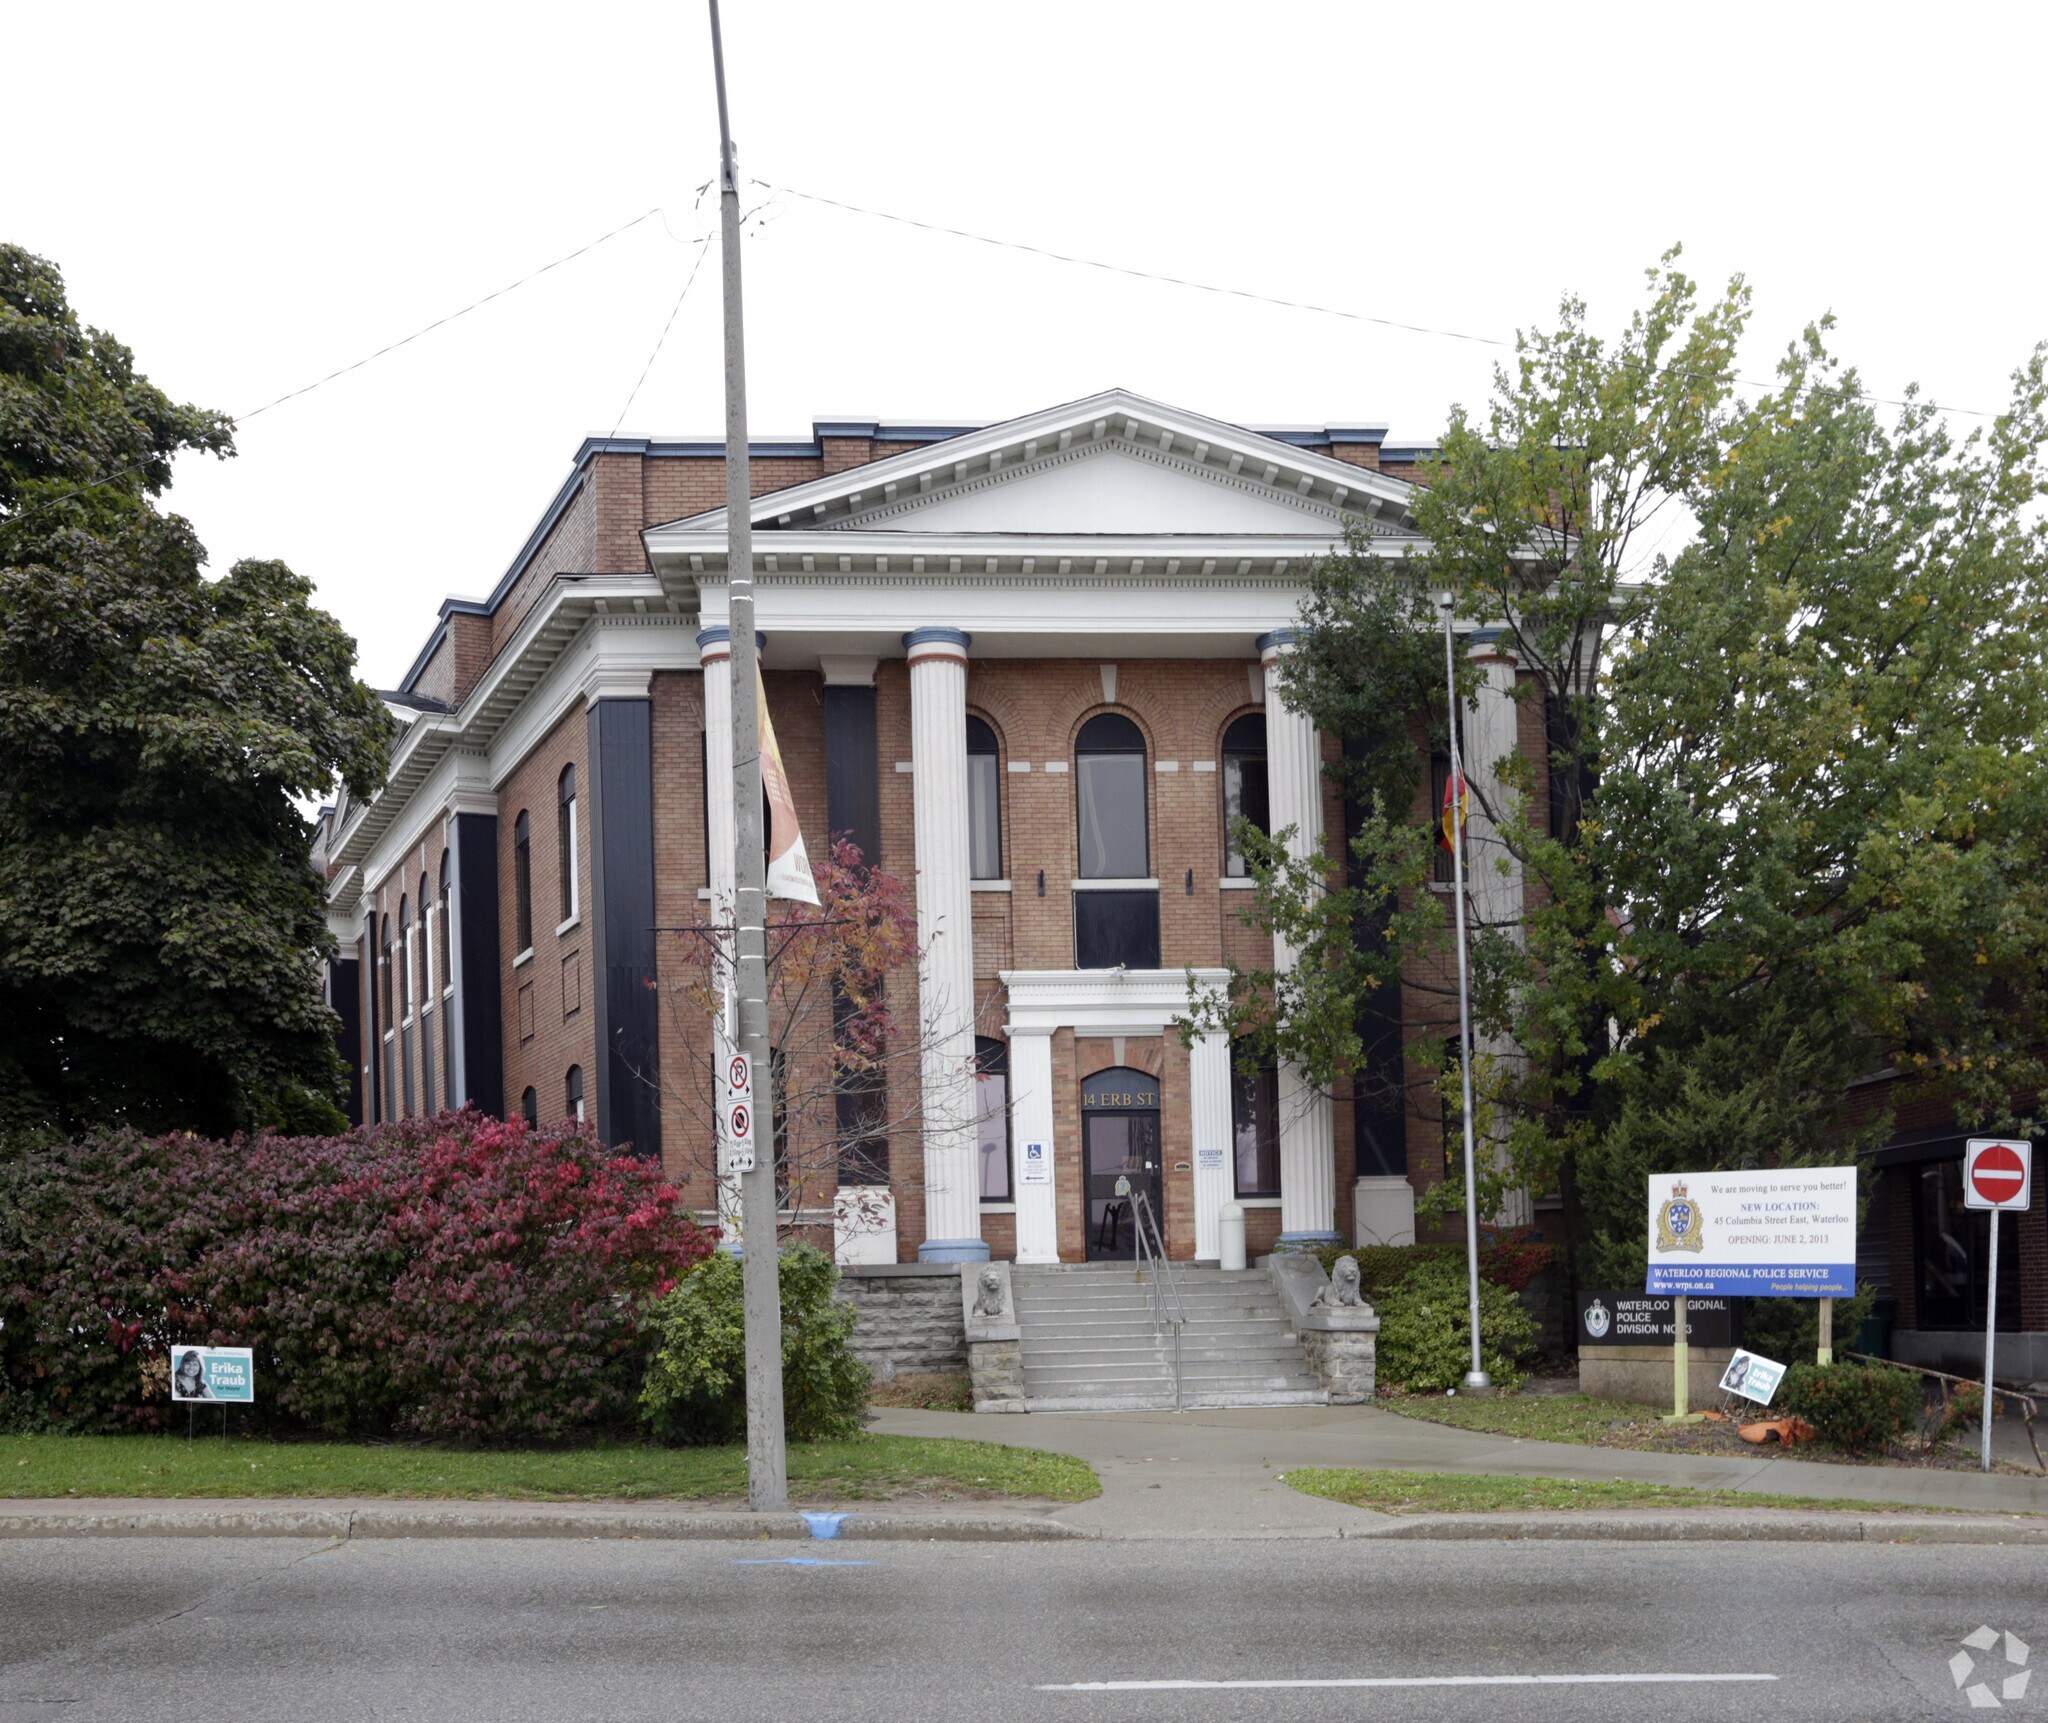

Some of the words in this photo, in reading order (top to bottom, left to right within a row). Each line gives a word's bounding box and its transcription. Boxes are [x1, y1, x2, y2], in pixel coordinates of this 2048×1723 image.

[1084, 1094, 1095, 1106] 14
[1101, 1093, 1132, 1106] ERB
[1137, 1093, 1154, 1106] ST
[1711, 1185, 1723, 1194] We
[1739, 1184, 1768, 1195] moving
[1770, 1183, 1778, 1192] to
[1803, 1184, 1818, 1193] you
[1820, 1181, 1847, 1191] better!
[1741, 1203, 1762, 1212] NEW
[1765, 1202, 1820, 1212] LOCATION:
[1714, 1216, 1723, 1225] 45
[1725, 1215, 1763, 1225] Columbia
[1764, 1215, 1787, 1225] Street
[1789, 1214, 1809, 1225] East,
[1811, 1214, 1849, 1224] Waterloo
[1728, 1235, 1771, 1245] OPENING:
[1773, 1235, 1797, 1244] JUNE
[1799, 1235, 1807, 1245] 2,
[1809, 1234, 1829, 1244] 2013
[1654, 1268, 1703, 1278] WATERLOO
[1704, 1268, 1751, 1278] REGIONAL
[1753, 1268, 1786, 1279] POLICE
[1788, 1268, 1829, 1279] SERVICE
[1653, 1281, 1714, 1291] www.wrps.on.ca
[1771, 1282, 1793, 1291] People
[1794, 1283, 1820, 1292] helping
[1616, 1300, 1670, 1311] WATERLOO
[1687, 1300, 1727, 1311] GIONAL
[1616, 1312, 1651, 1322] POLICE
[1616, 1324, 1659, 1334] DIVISION
[1686, 1324, 1692, 1334] 3
[211, 1362, 243, 1374] Erika
[209, 1374, 246, 1386] Traub
[1752, 1367, 1774, 1383] Erika
[1748, 1375, 1771, 1392] Traub
